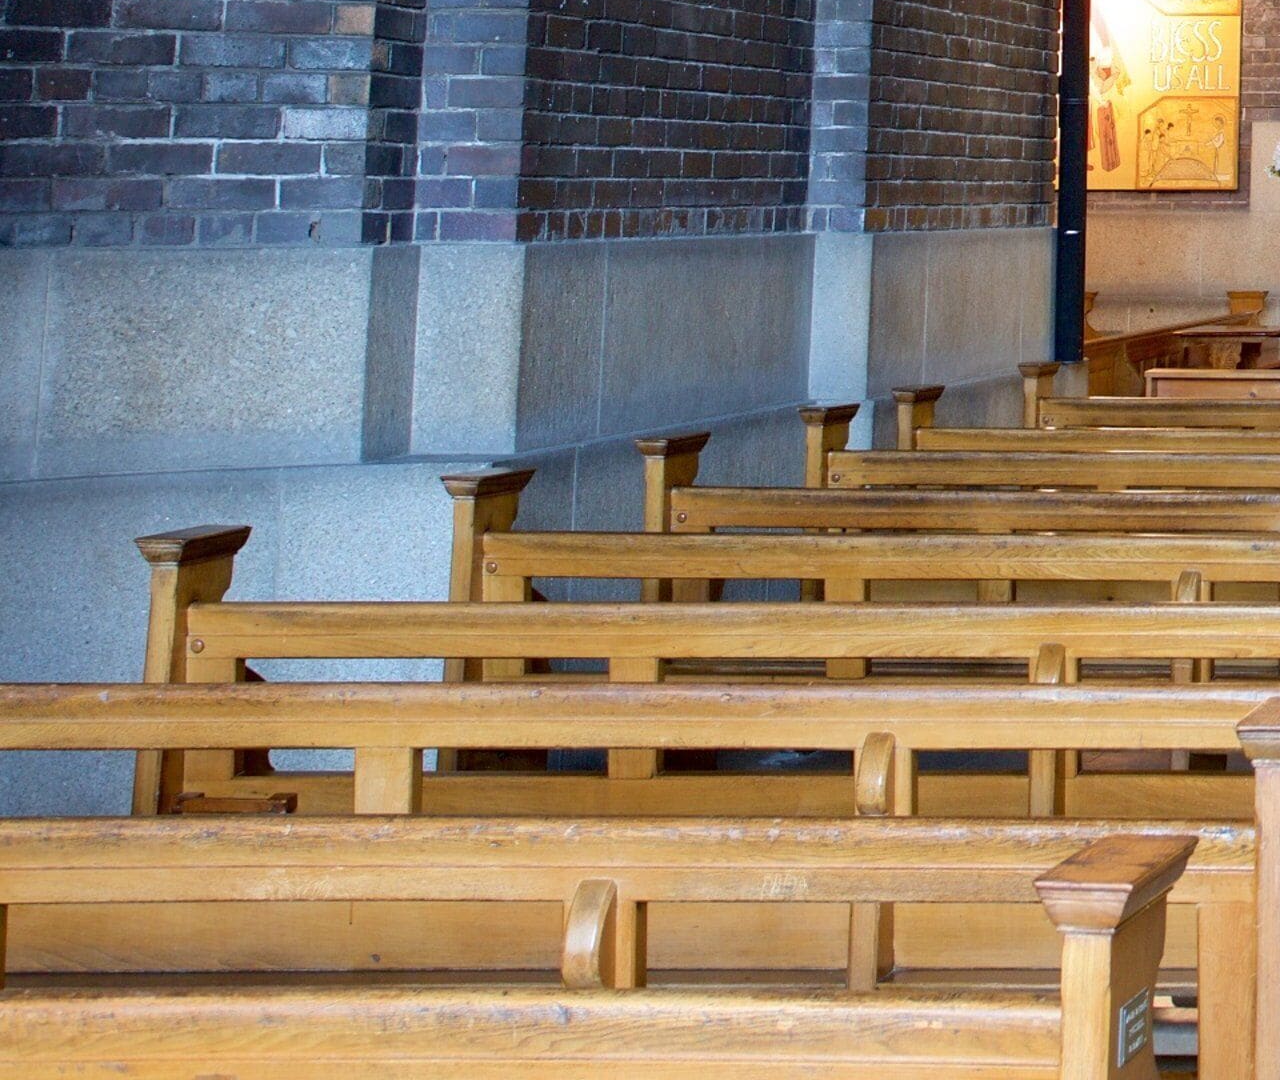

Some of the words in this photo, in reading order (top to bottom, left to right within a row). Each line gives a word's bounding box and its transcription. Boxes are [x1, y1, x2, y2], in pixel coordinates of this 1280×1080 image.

[1150, 20, 1223, 63] BLESS
[1153, 64, 1184, 92] US
[1184, 64, 1232, 91] ALL
